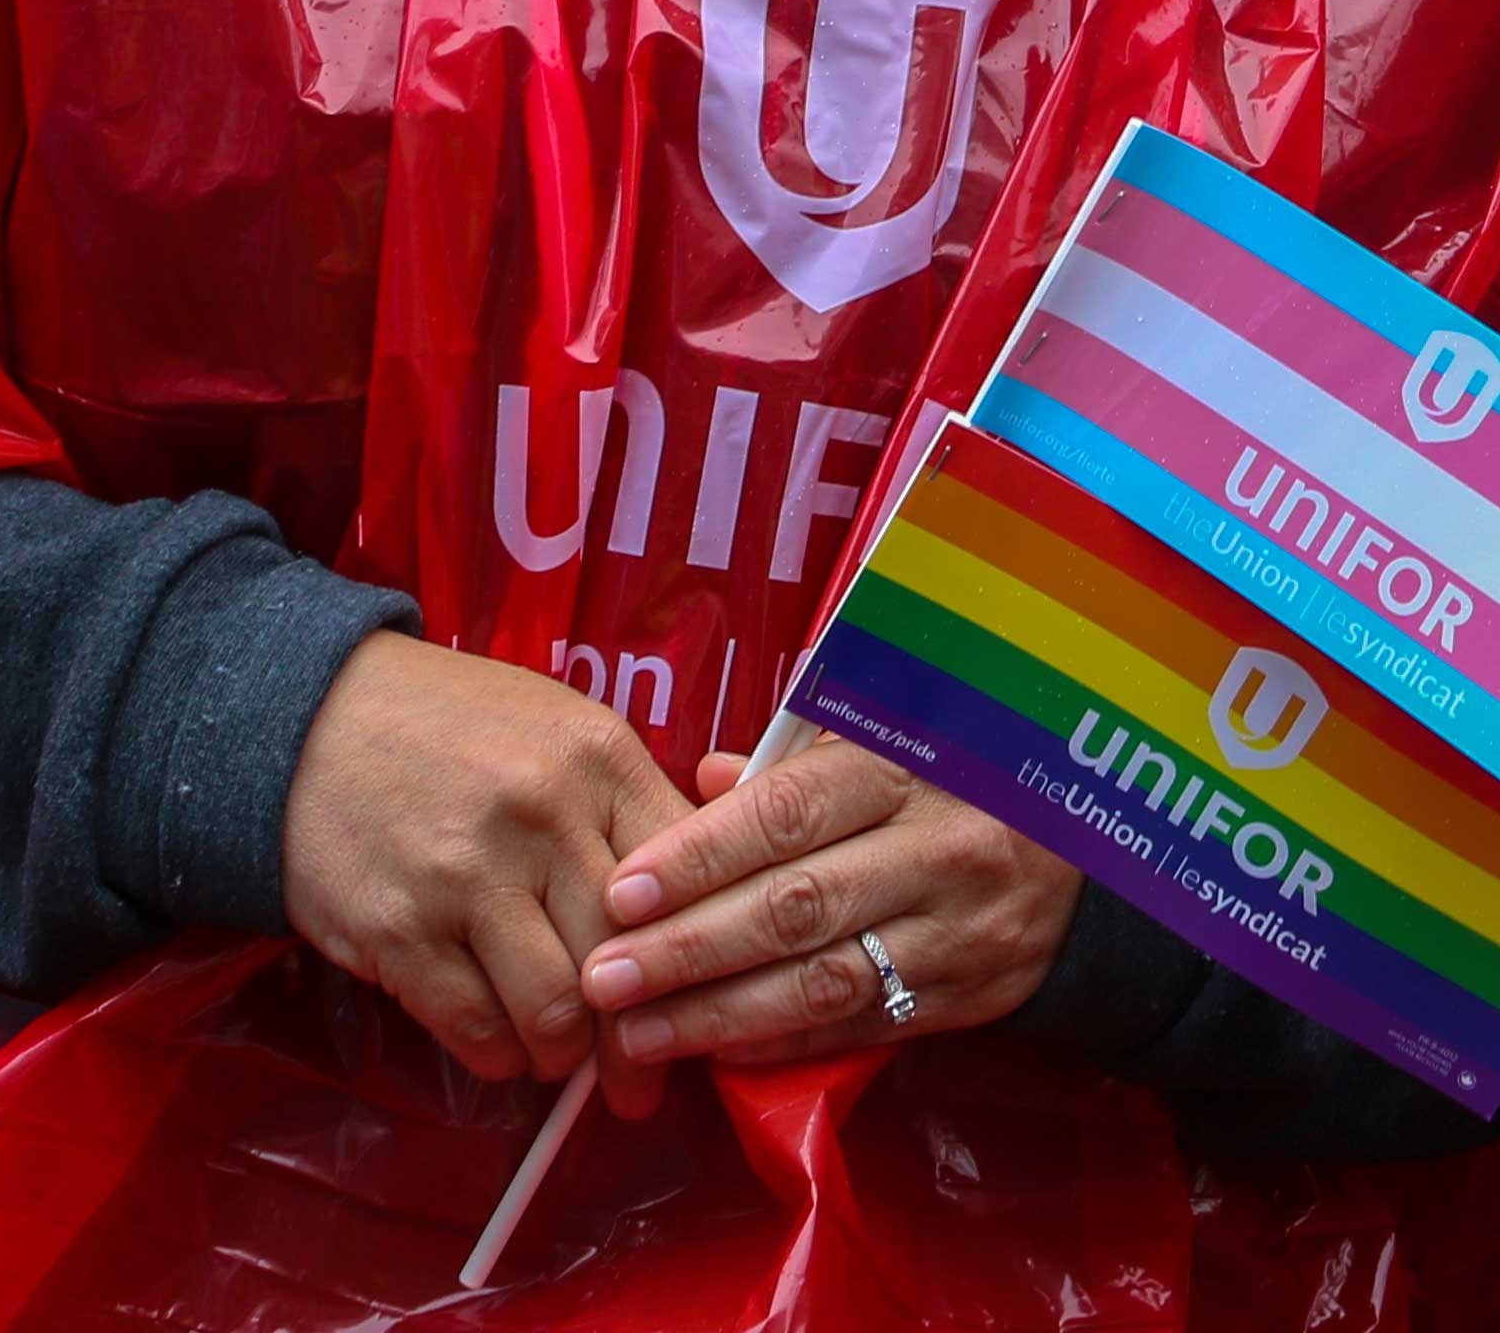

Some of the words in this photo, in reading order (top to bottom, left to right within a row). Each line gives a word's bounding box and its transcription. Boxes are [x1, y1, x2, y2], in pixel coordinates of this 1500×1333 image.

[1162, 492, 1300, 603] theUnion
[1318, 595, 1466, 719] lesyndicat
[816, 693, 936, 763] unifor.org/pride
[1015, 757, 1154, 861] theUnion
[1172, 854, 1328, 972] lesyndicat
